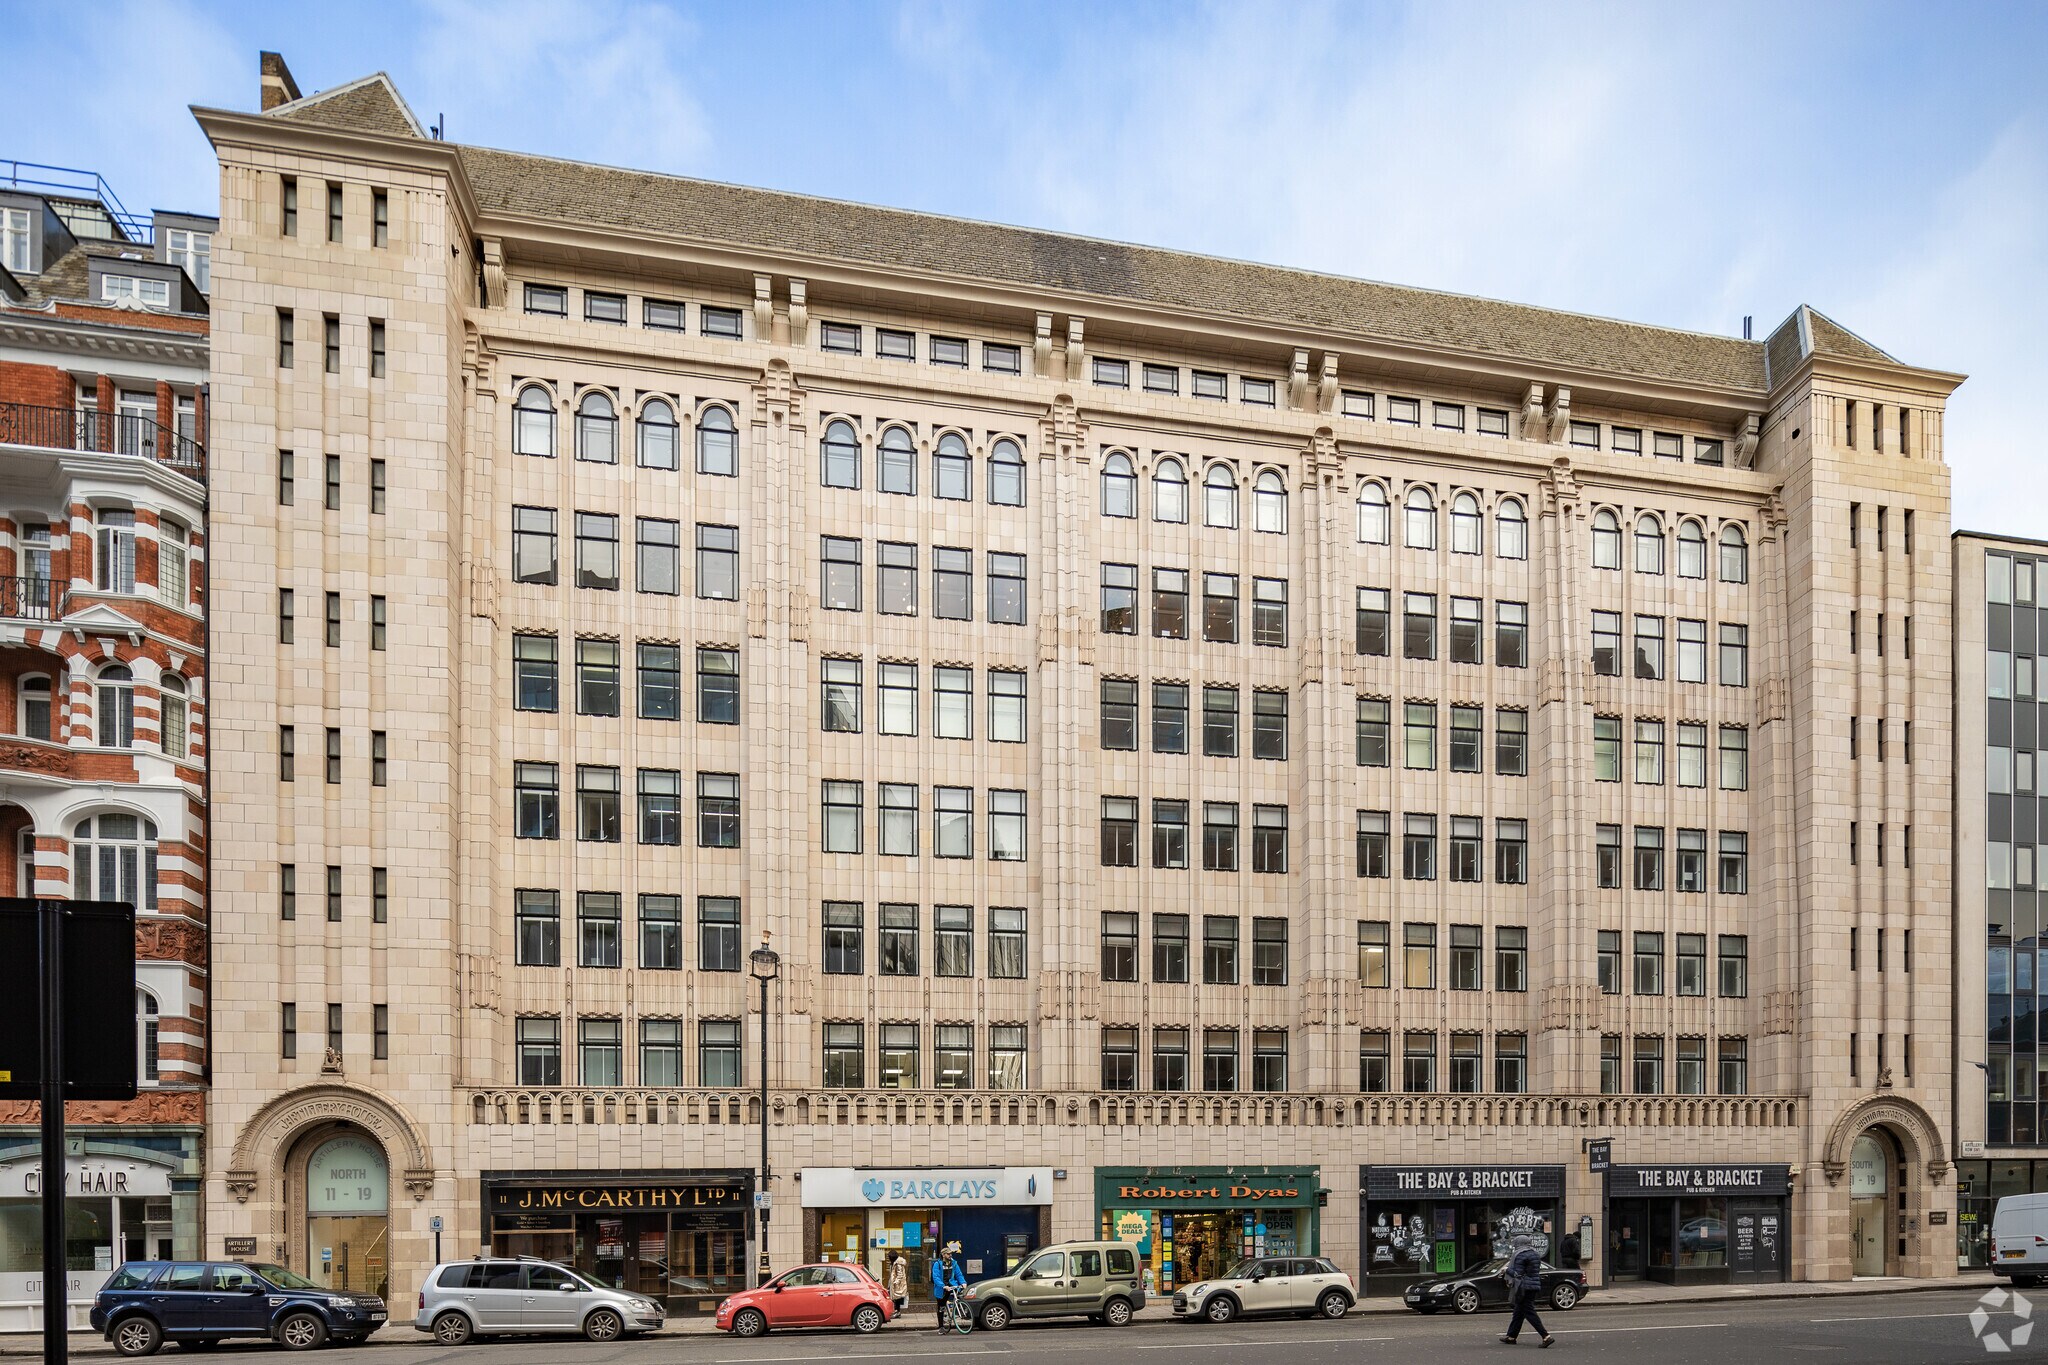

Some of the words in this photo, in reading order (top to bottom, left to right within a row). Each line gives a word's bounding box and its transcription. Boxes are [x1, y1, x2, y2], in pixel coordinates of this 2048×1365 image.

[72, 1142, 79, 1150] 7
[314, 1140, 354, 1169] ARTILLERY
[358, 1143, 384, 1169] HOUSE
[1852, 1160, 1873, 1169] SOUTH
[331, 1169, 366, 1179] NORTH
[1397, 1172, 1423, 1189] THE
[1428, 1172, 1453, 1189] BAY
[1458, 1171, 1468, 1188] &
[1472, 1171, 1534, 1188] BRACKET
[1638, 1170, 1662, 1187] THE
[1666, 1170, 1690, 1186] BAY
[1693, 1170, 1703, 1186] &
[1707, 1169, 1763, 1186] BRACKET
[1867, 1175, 1876, 1186] 19
[80, 1172, 129, 1192] HAIR
[325, 1187, 336, 1200] 11
[357, 1187, 372, 1200] 19
[890, 1180, 997, 1199] BARCLAYS
[1118, 1186, 1221, 1198] Robert
[1229, 1186, 1299, 1200] Dyas
[1390, 1229, 1408, 1241] NFL
